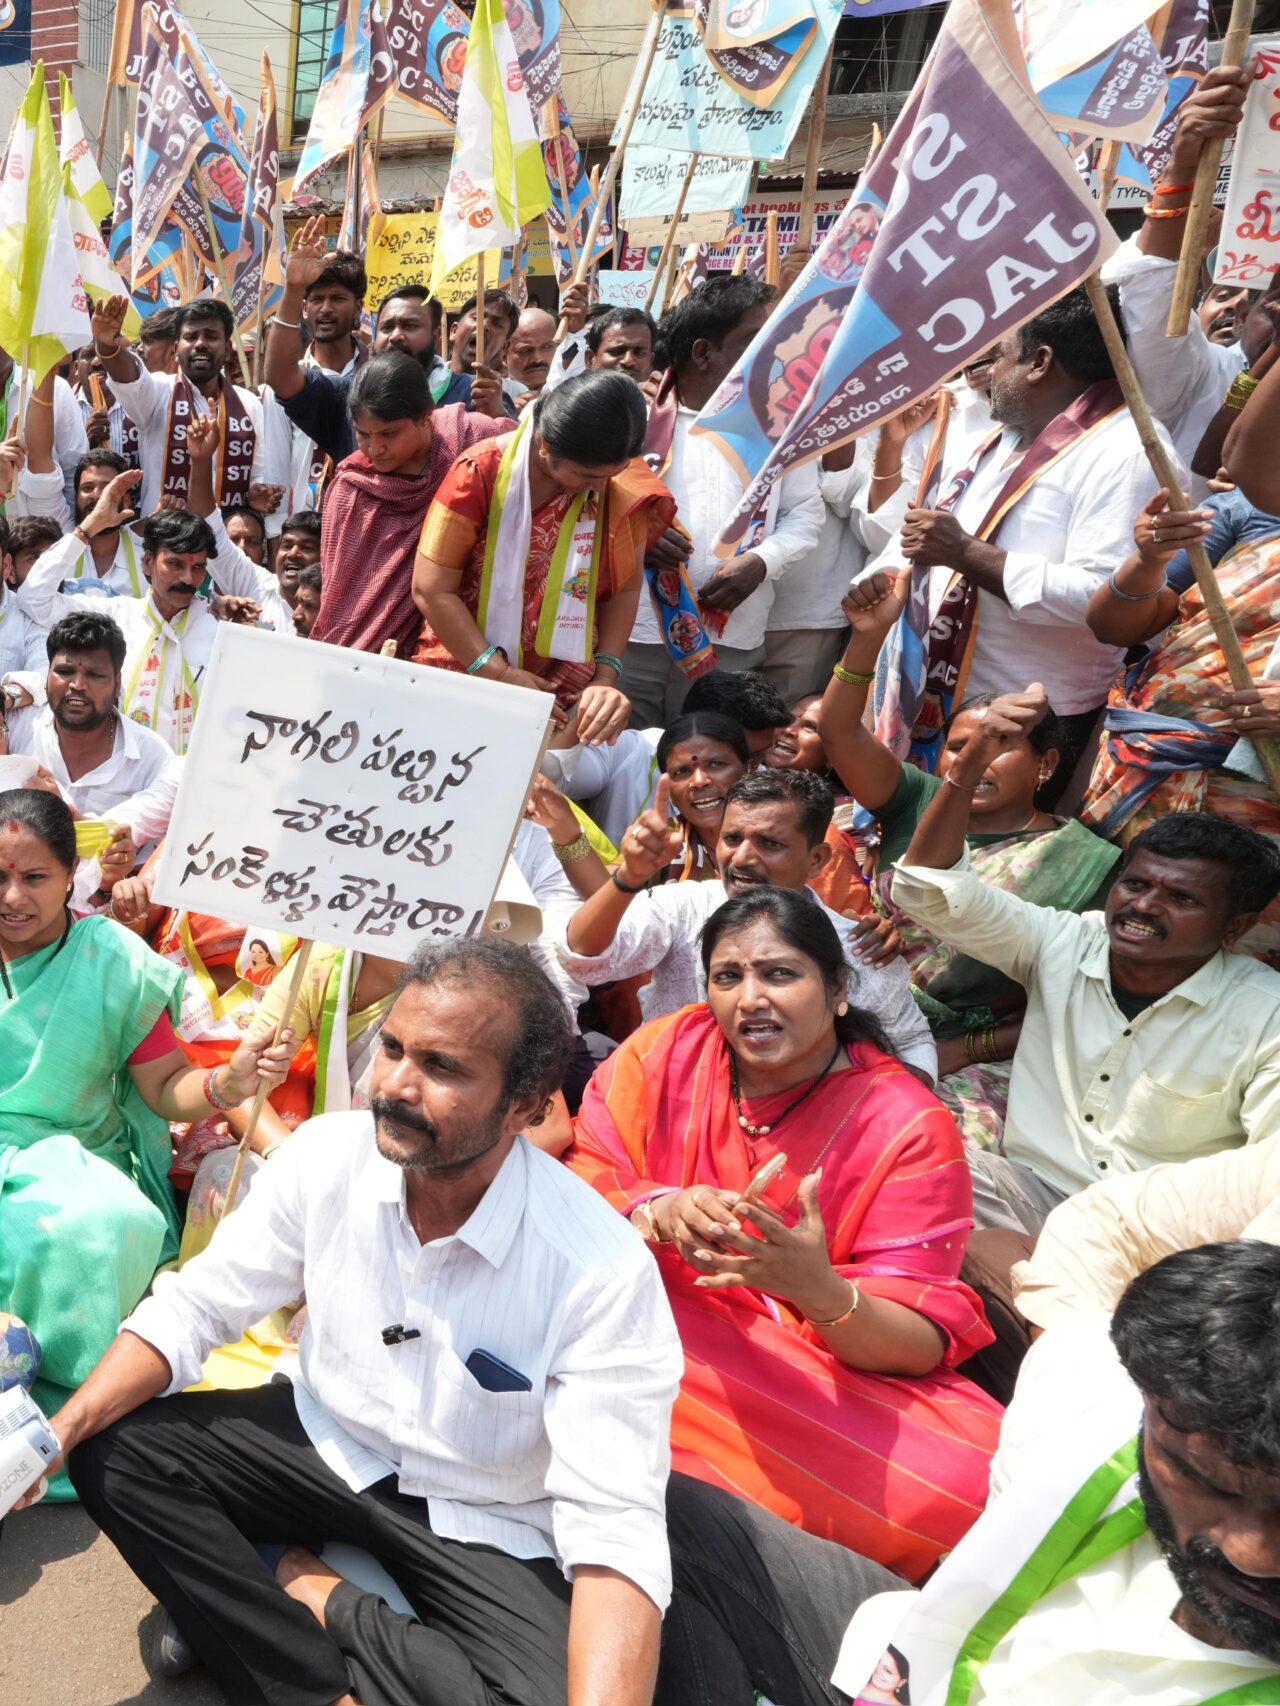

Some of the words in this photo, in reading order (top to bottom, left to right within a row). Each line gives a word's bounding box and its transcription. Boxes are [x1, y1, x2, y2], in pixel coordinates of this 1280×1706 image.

[389, 28, 423, 60] ST
[228, 416, 254, 432] BC
[228, 440, 254, 457] SC
[226, 465, 252, 482] ST
[163, 475, 188, 492] JA
[240, 710, 360, 765] నాగలి
